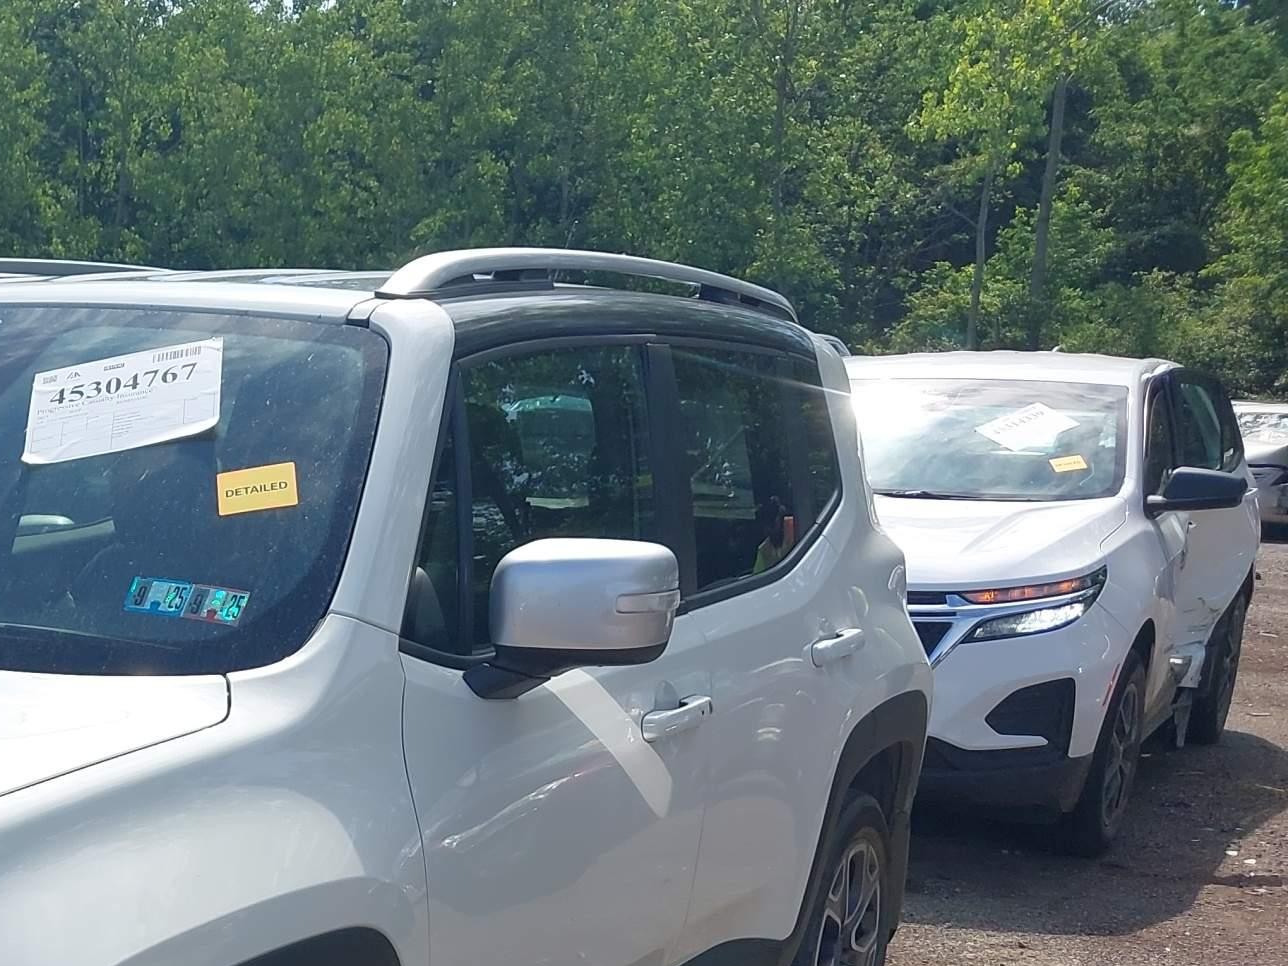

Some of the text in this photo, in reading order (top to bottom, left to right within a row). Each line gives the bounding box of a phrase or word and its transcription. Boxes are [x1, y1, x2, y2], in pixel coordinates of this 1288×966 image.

[49, 362, 198, 405] 45304767
[224, 480, 289, 499] DETAILED
[167, 586, 188, 610] 25
[224, 594, 246, 619] 25
